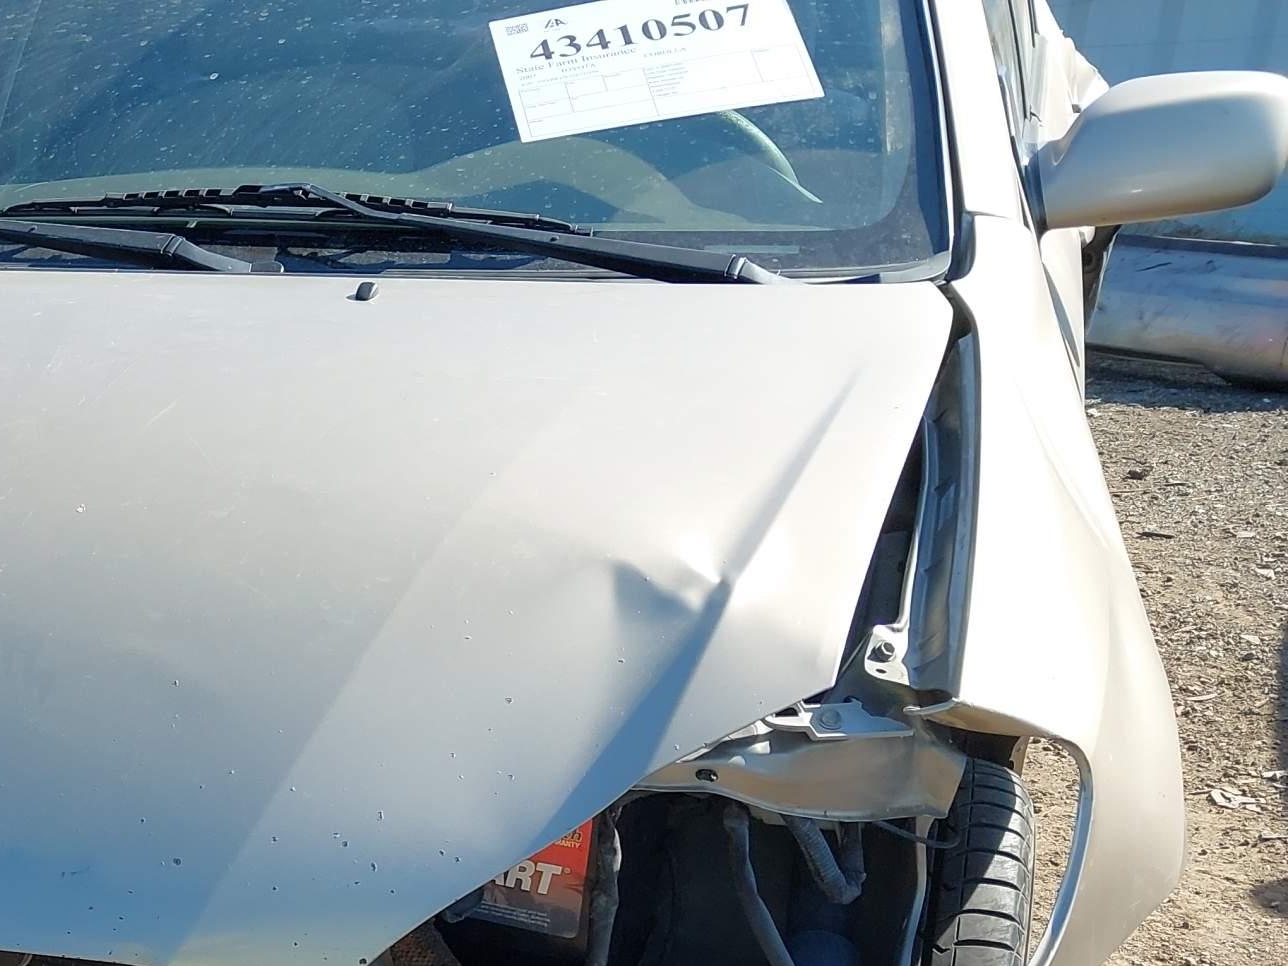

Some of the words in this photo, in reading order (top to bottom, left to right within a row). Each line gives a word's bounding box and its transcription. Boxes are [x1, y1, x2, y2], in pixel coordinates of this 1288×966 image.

[530, 4, 749, 60] 43410507
[516, 62, 545, 75] State
[548, 57, 578, 70] Farm
[581, 47, 637, 63] Insurance
